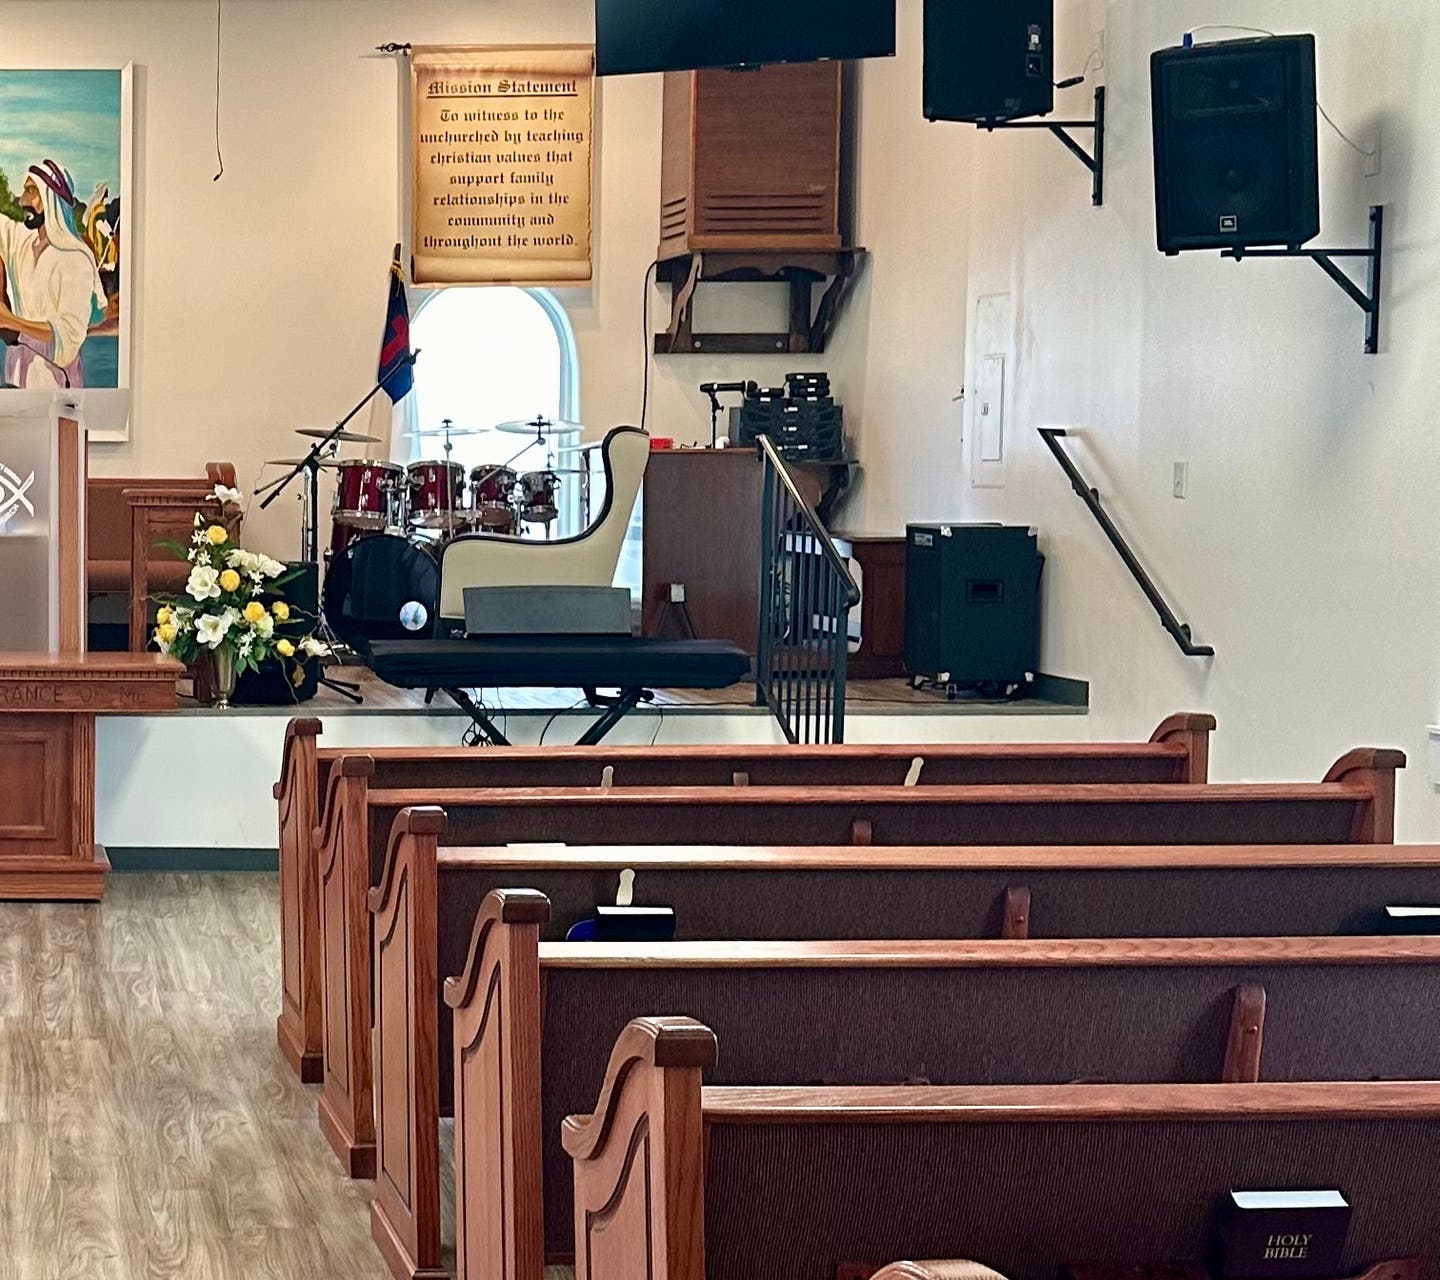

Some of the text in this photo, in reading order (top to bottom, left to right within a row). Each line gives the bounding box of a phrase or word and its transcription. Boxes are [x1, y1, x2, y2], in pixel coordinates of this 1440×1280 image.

[427, 80, 577, 95] Mission Statement
[440, 108, 565, 123] To witness to the
[420, 129, 584, 146] unchurched by teaching
[430, 150, 573, 166] christian values that
[449, 171, 554, 187] support family
[433, 192, 570, 208] relationships in the
[447, 213, 555, 228] community and
[423, 233, 578, 250] throughout the world.
[120, 685, 147, 704] ME
[1267, 1234, 1313, 1247] HOLY
[1263, 1247, 1309, 1259] BIBLE
